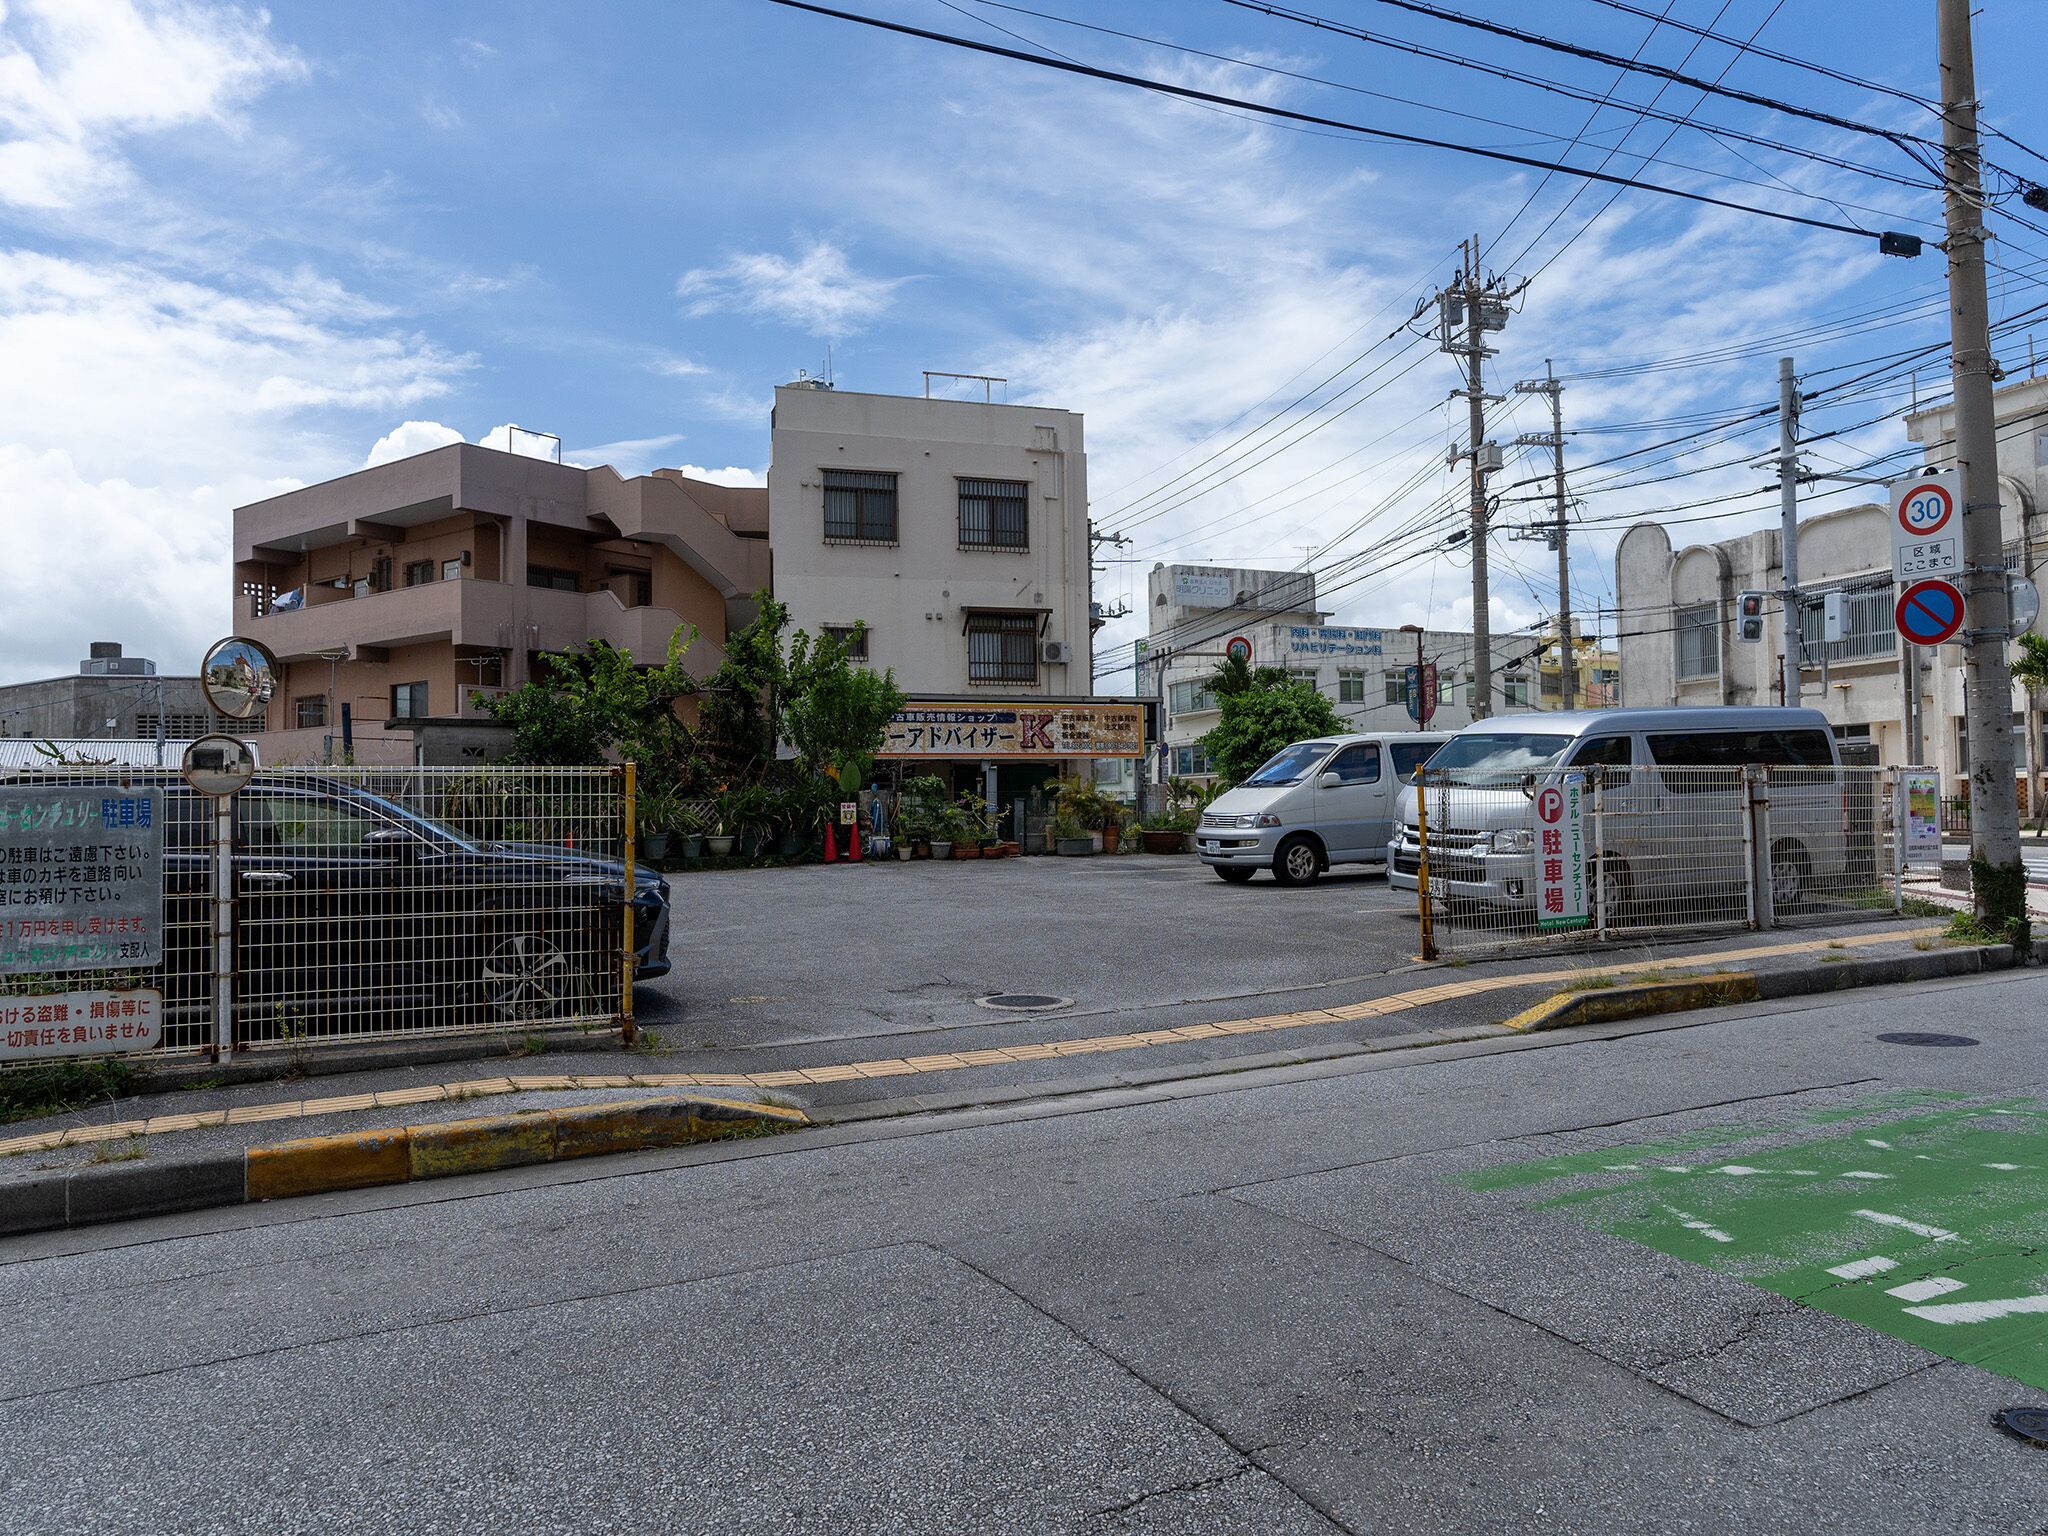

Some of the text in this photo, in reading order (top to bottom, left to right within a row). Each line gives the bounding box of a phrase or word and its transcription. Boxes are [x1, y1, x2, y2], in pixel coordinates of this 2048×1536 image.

[1911, 497, 1941, 523] 30
[1903, 555, 1953, 572] ここまで
[1913, 543, 1942, 558] 区域
[1291, 642, 1382, 656] リハビリテーション科
[890, 712, 998, 723] 古車販売情報ショップ
[880, 714, 1054, 749] ーアドバイザー K
[102, 798, 151, 829] 駐車場
[1544, 793, 1560, 820] P
[1569, 787, 1582, 912] ホテル ニューセンチュリー
[1542, 829, 1564, 913] 駐車場
[0, 917, 147, 937] 1万円を申し受けます。
[120, 941, 150, 958] 支配人
[0, 999, 151, 1025] ける盗難・損傷等に
